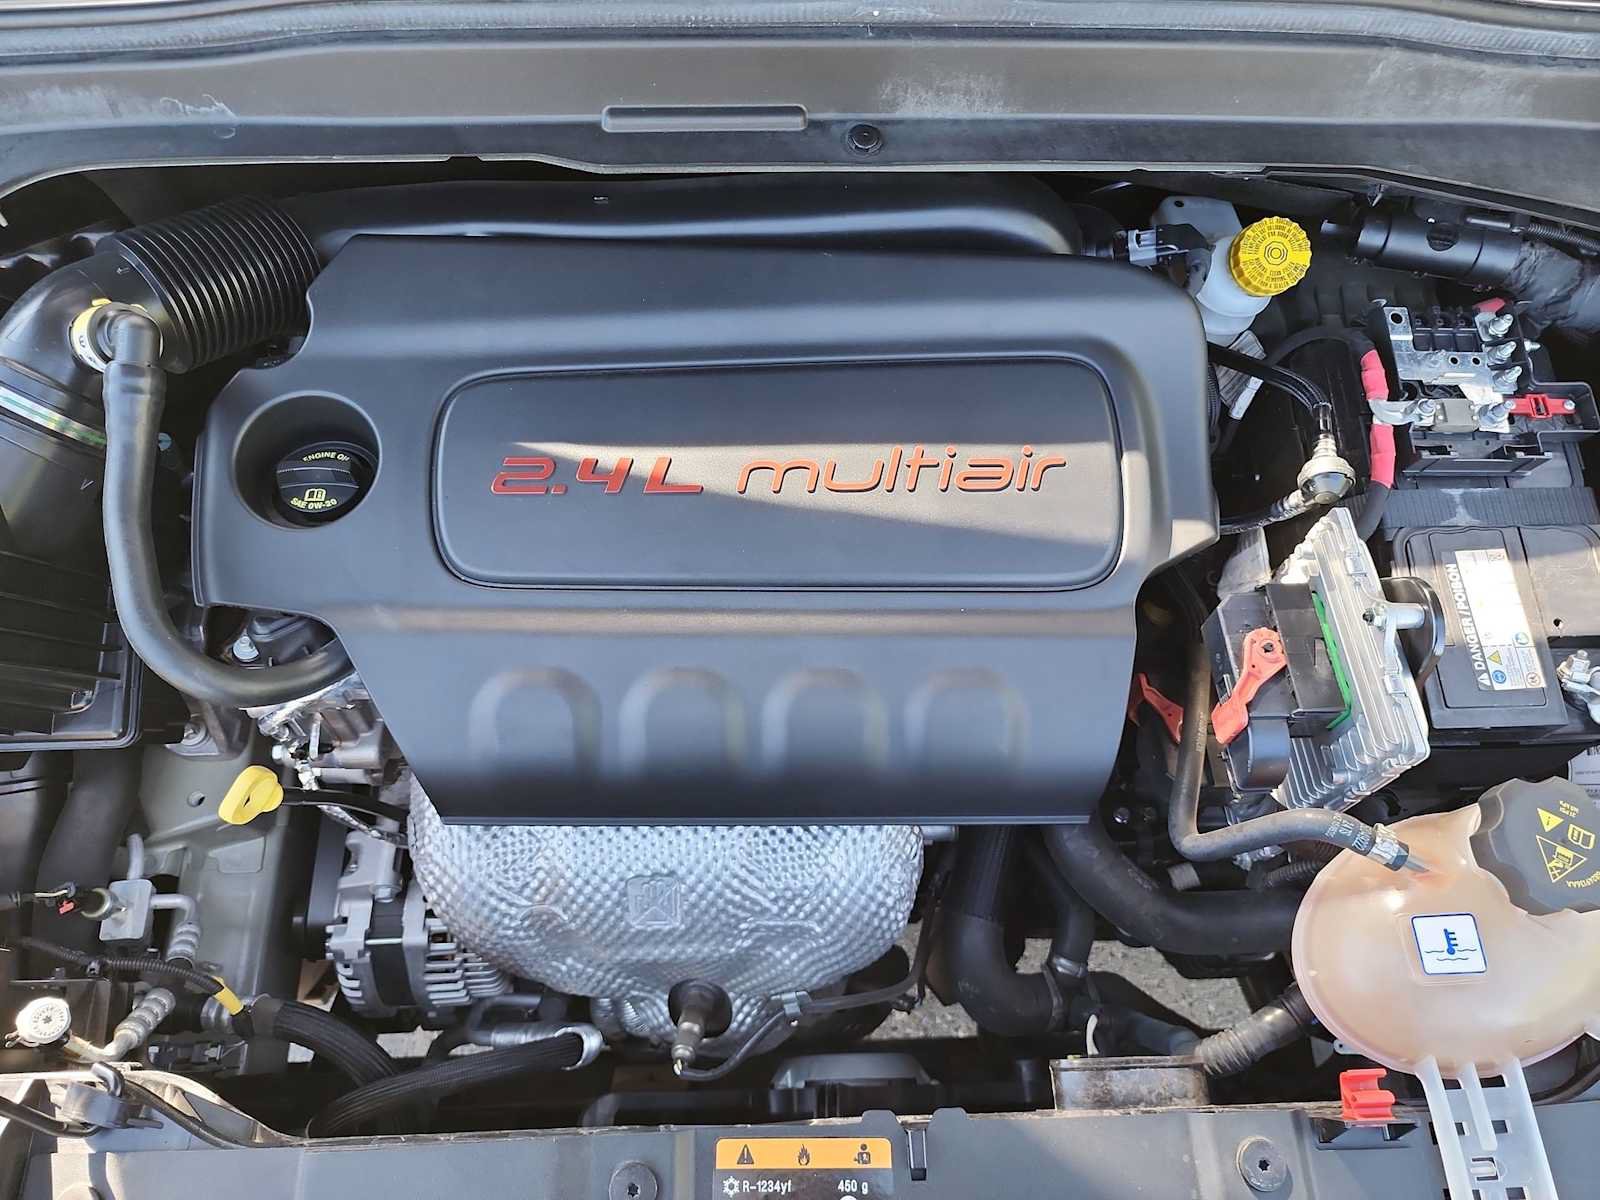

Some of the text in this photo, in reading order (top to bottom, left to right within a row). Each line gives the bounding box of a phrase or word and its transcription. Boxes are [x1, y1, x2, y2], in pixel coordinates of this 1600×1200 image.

[302, 452, 336, 462] ENGINE
[490, 444, 1067, 495] 2.4L multiair
[290, 497, 337, 510] SAE 0W-20
[742, 1180, 869, 1195] R-1234yf 450 g
